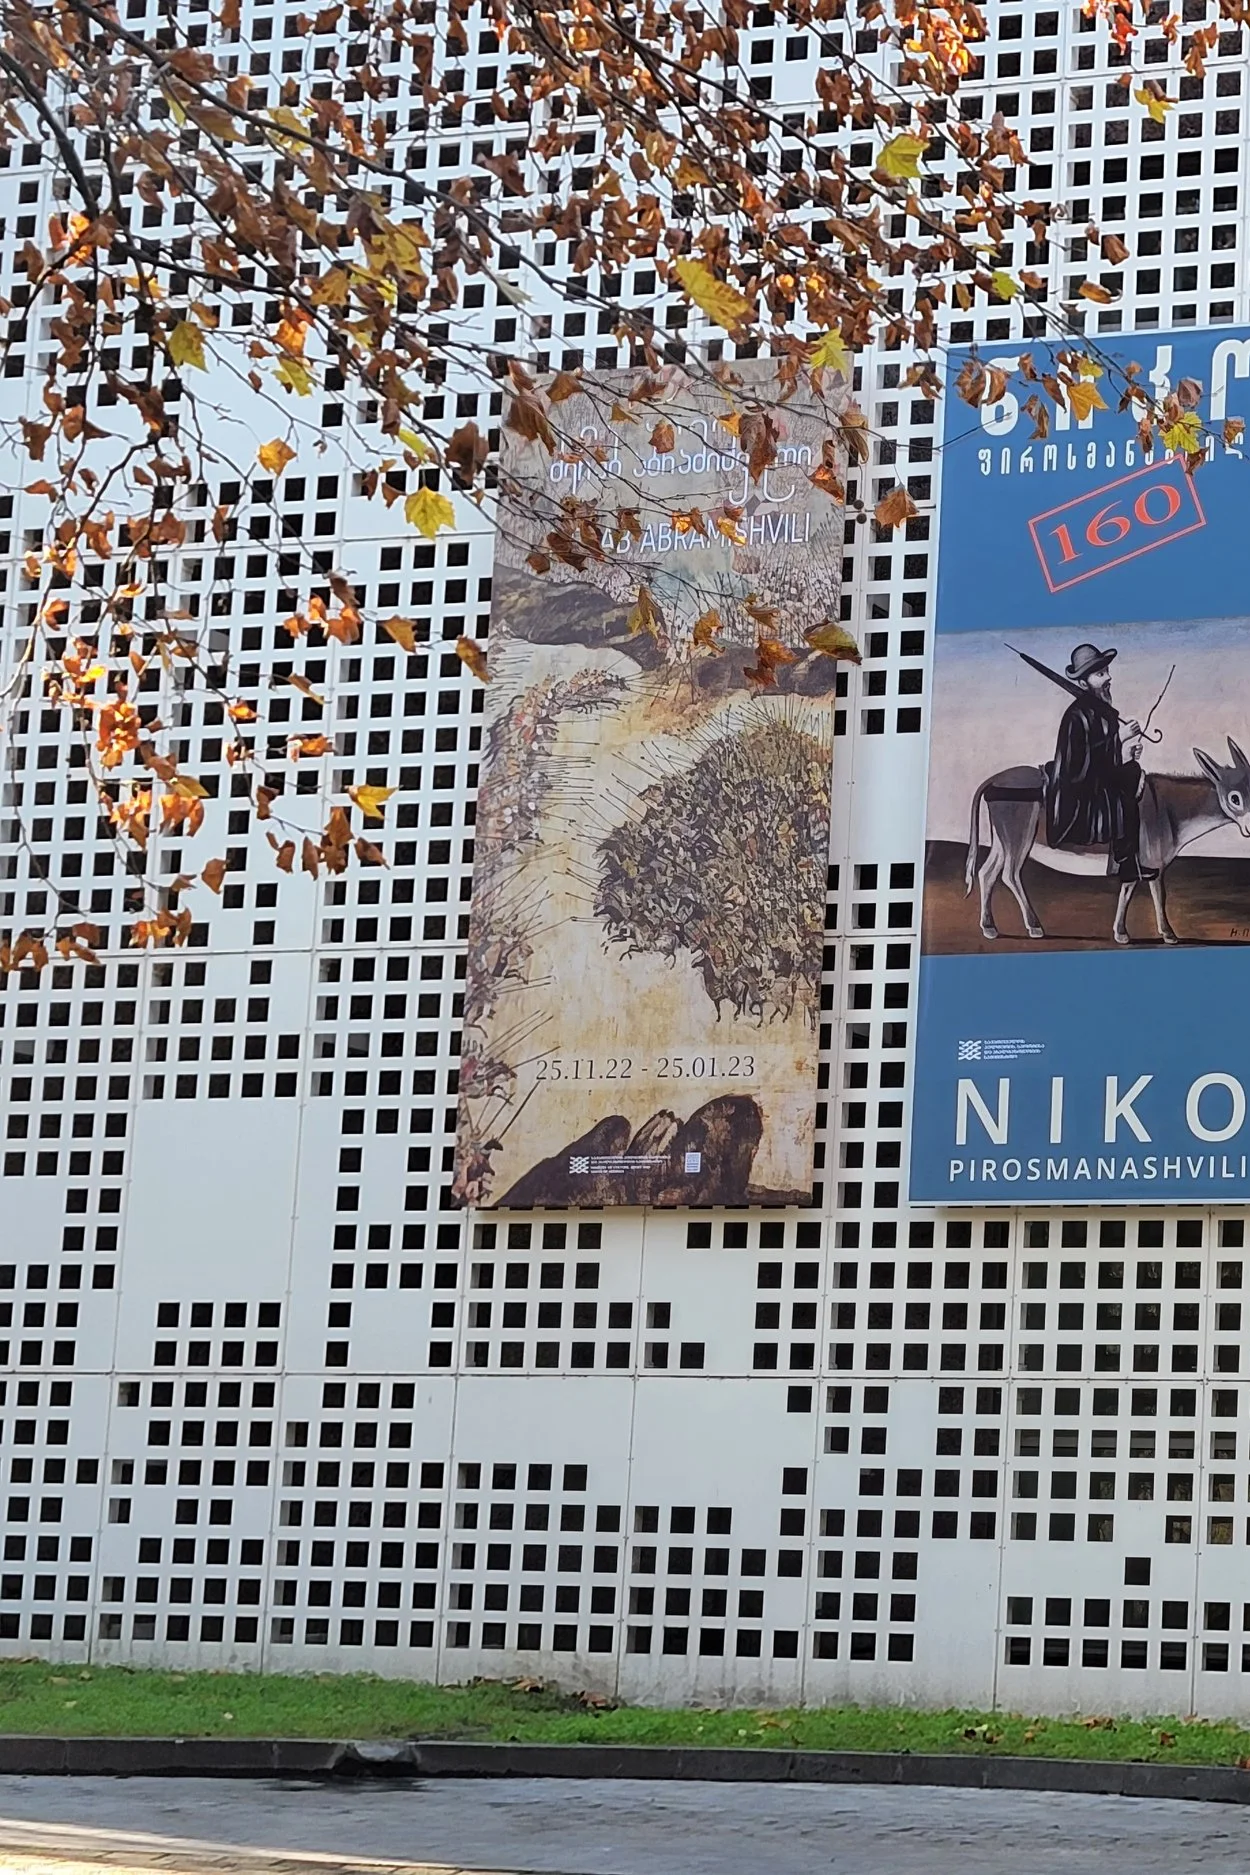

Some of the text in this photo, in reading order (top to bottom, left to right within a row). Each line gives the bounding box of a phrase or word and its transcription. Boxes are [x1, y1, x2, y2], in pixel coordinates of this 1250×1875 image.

[1048, 483, 1182, 565] 160
[535, 1057, 633, 1082] 25.11.22
[656, 1054, 756, 1079] 25.01.23
[955, 1072, 1248, 1146] NIKO
[949, 1155, 1248, 1182] PIROSMANASHVILI
